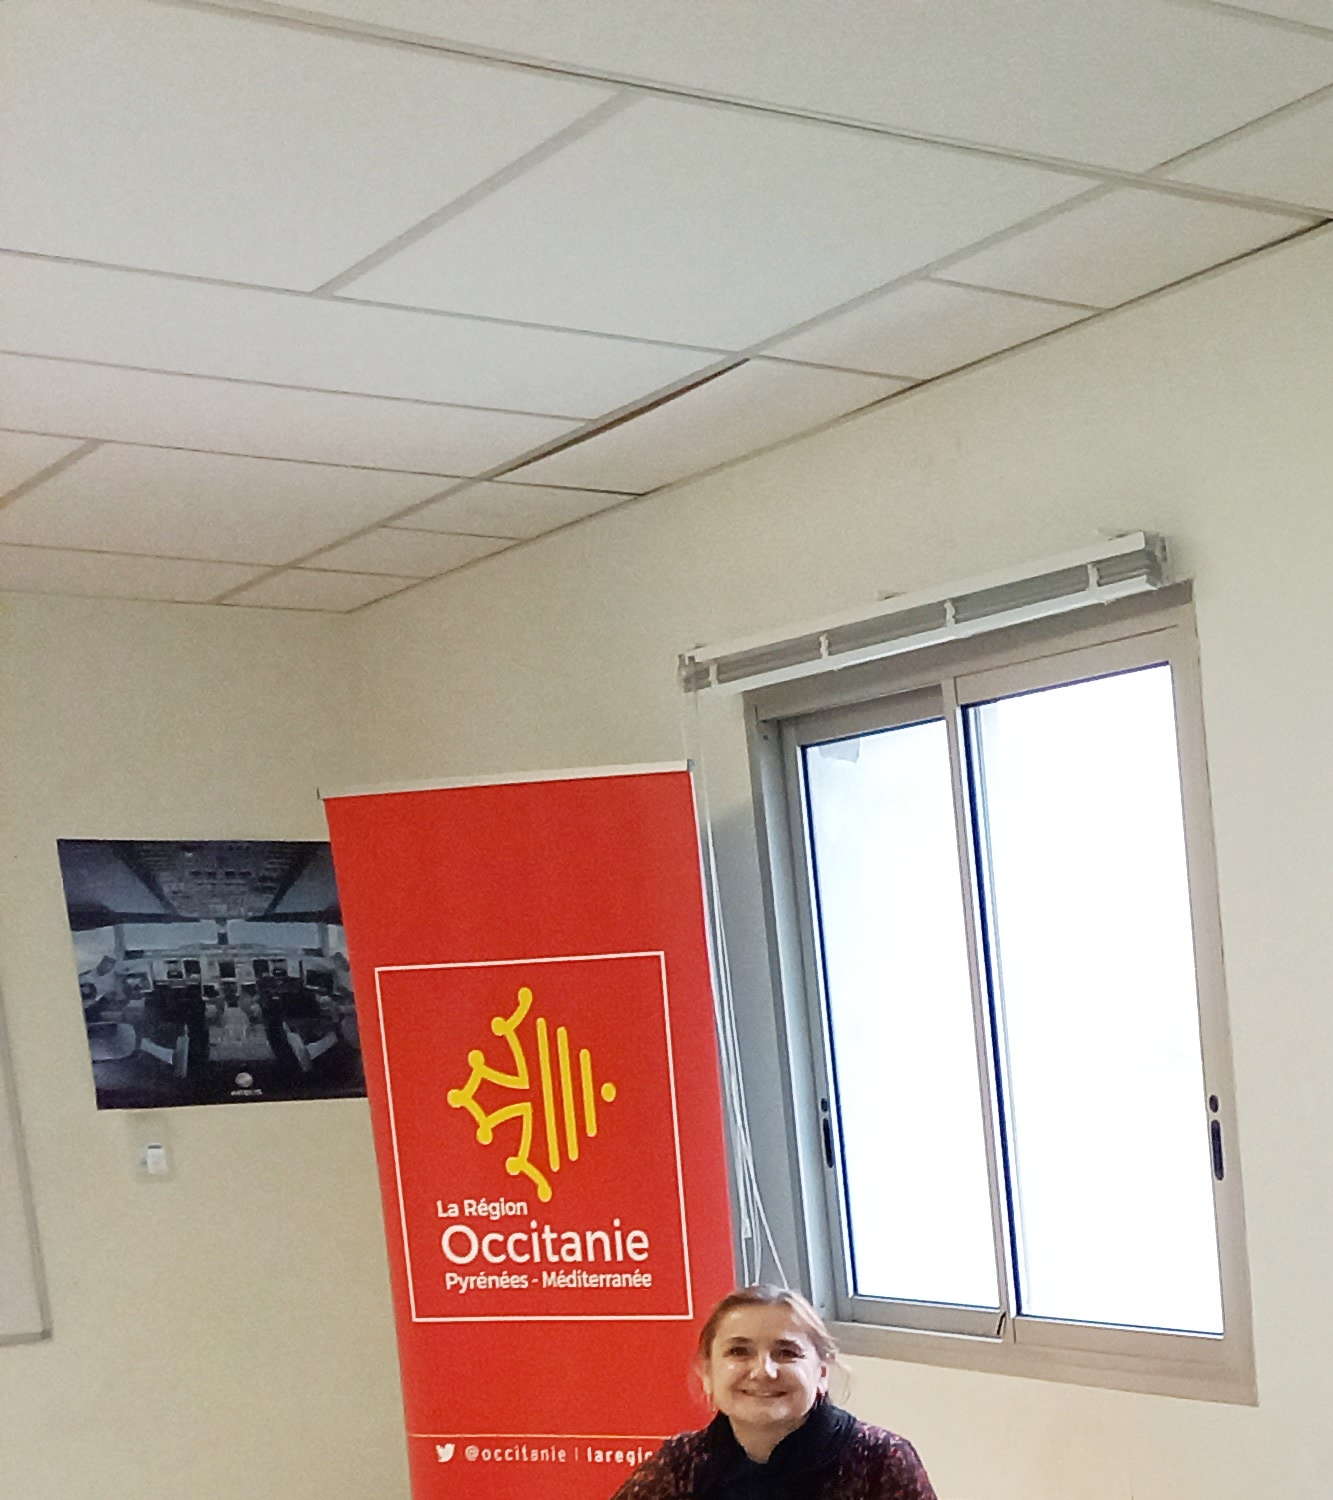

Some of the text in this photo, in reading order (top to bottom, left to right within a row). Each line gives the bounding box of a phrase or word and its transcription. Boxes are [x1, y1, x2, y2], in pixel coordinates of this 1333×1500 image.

[436, 1197, 528, 1220] La Région
[441, 1218, 650, 1264] Occitanie
[445, 1271, 529, 1294] Pyrénées
[542, 1269, 652, 1289] Méditerranée
[464, 1444, 567, 1463] @occitanie
